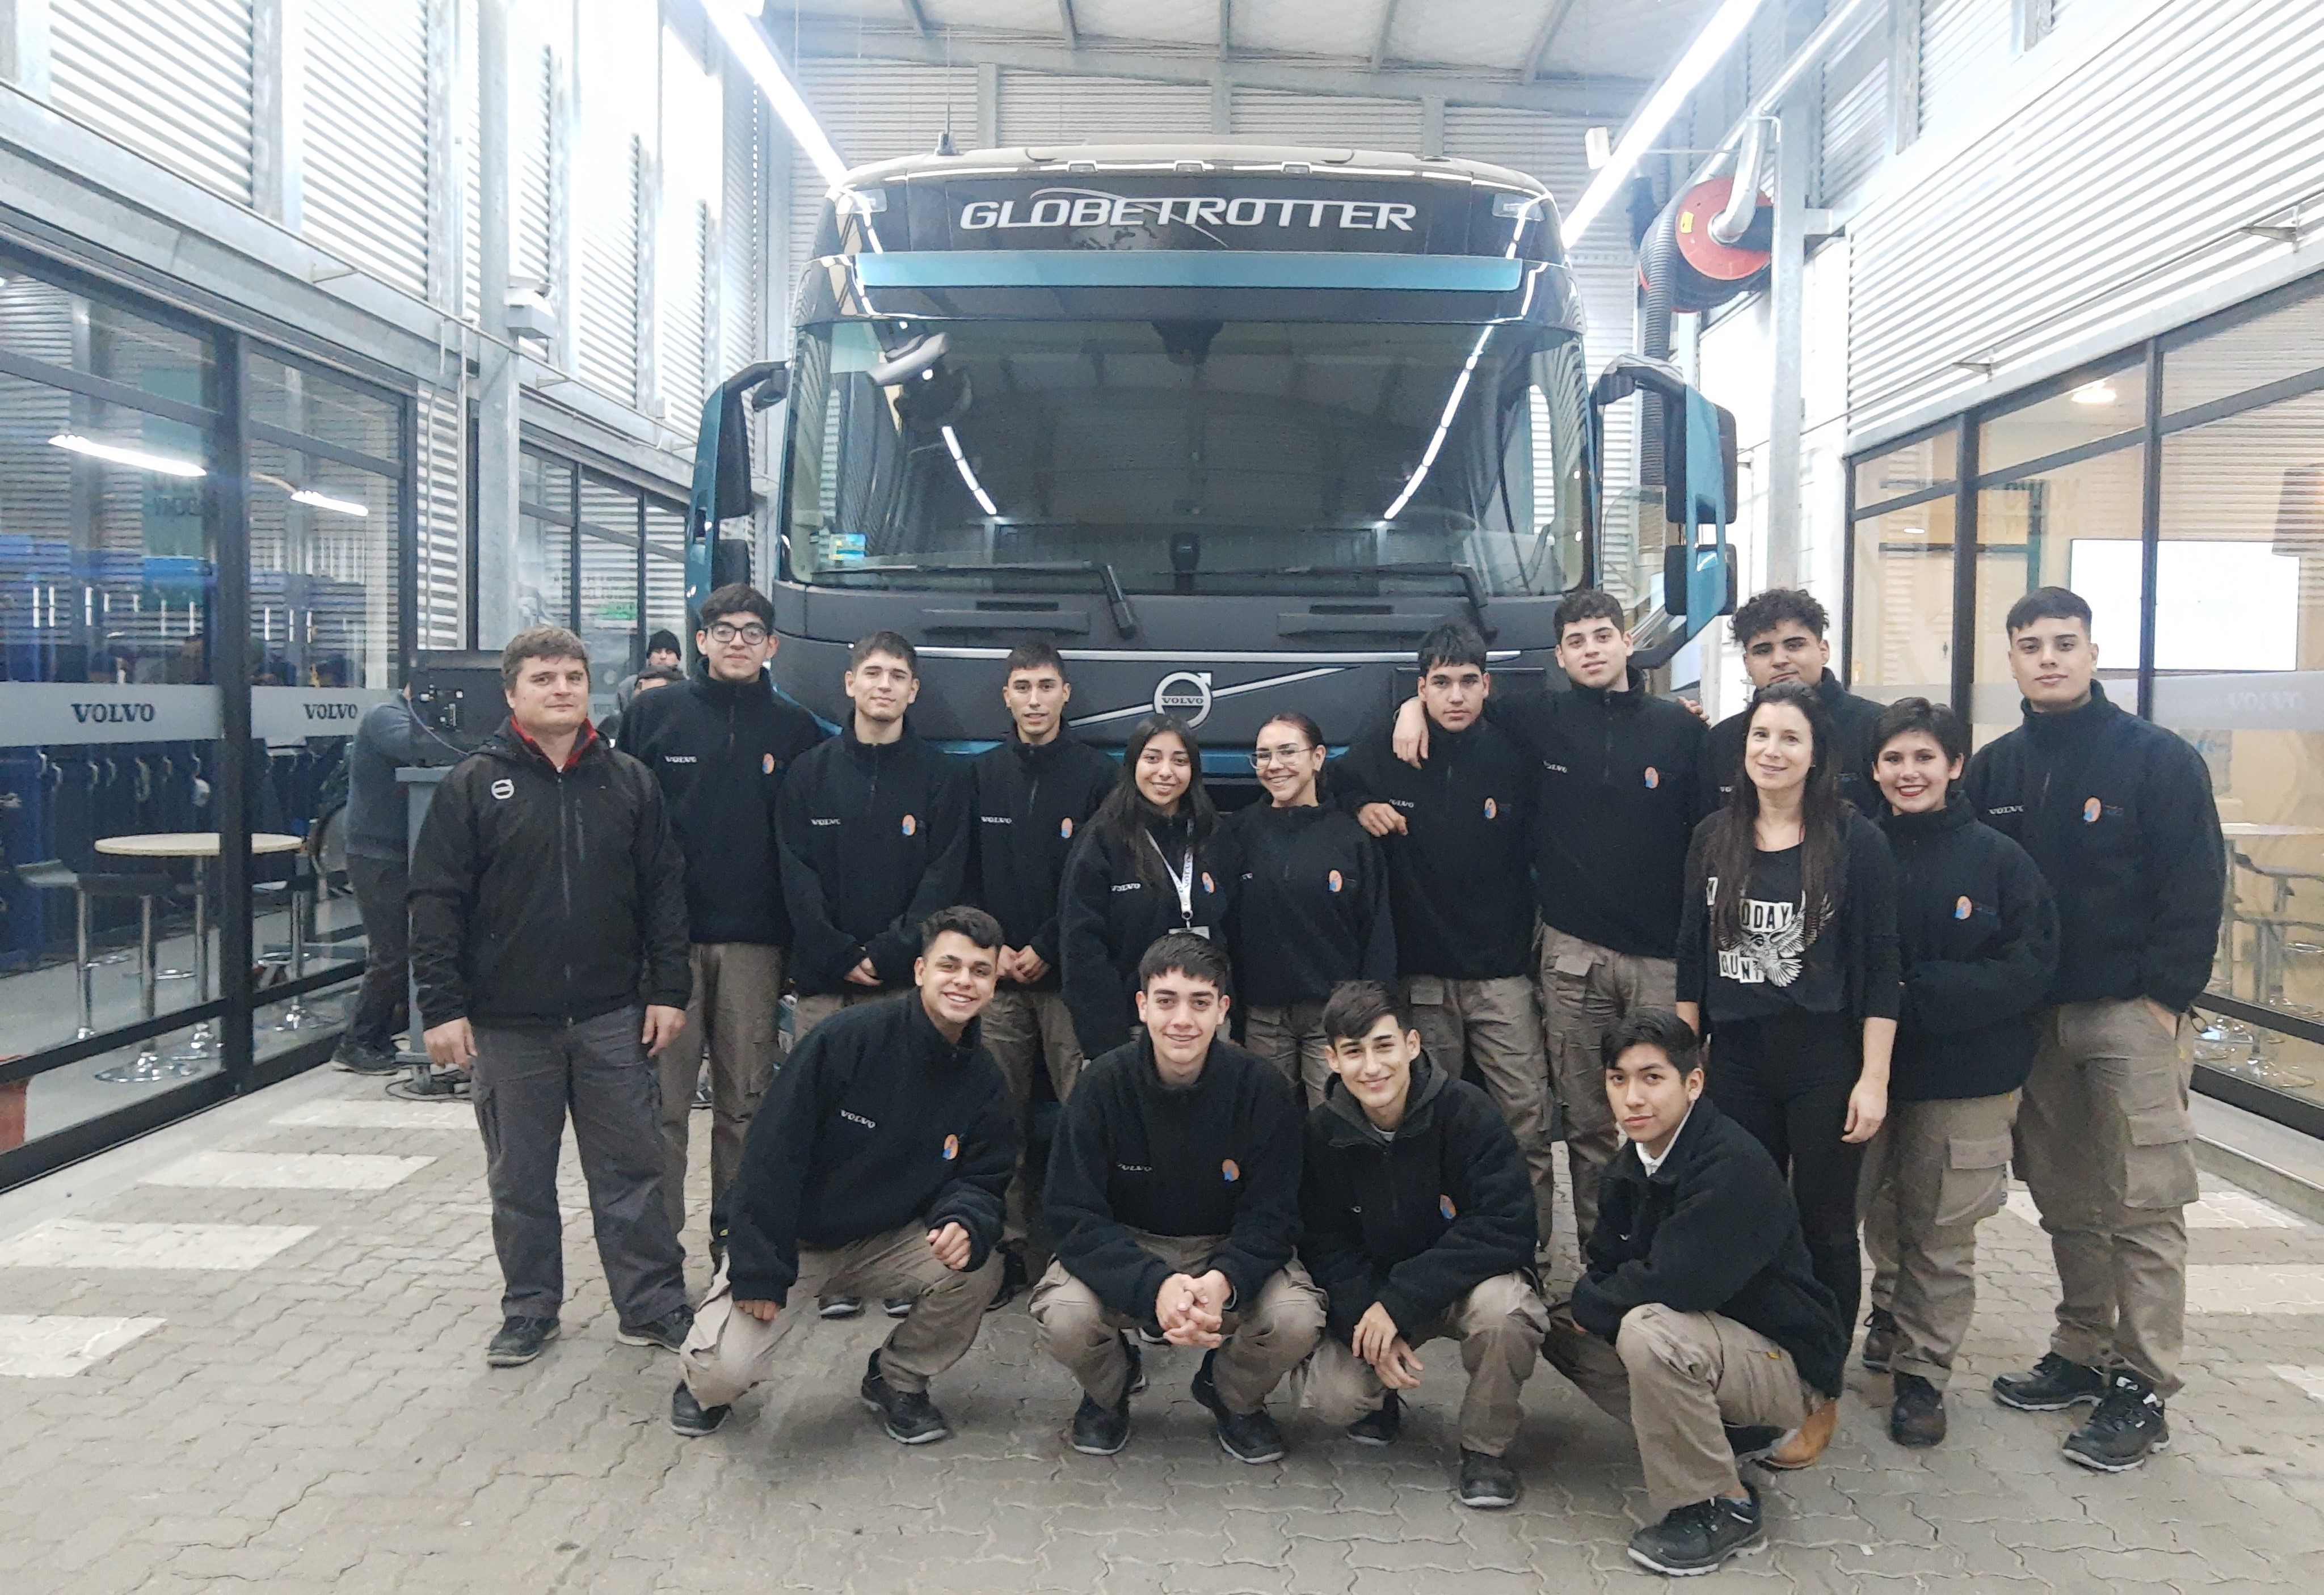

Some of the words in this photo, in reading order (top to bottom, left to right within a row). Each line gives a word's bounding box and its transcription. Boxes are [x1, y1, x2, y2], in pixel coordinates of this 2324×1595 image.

[959, 197, 1417, 232] GLOBETROTTER
[71, 703, 154, 723] VOLVO
[303, 703, 358, 719] VOLVO
[840, 1109, 876, 1129] VOLVO
